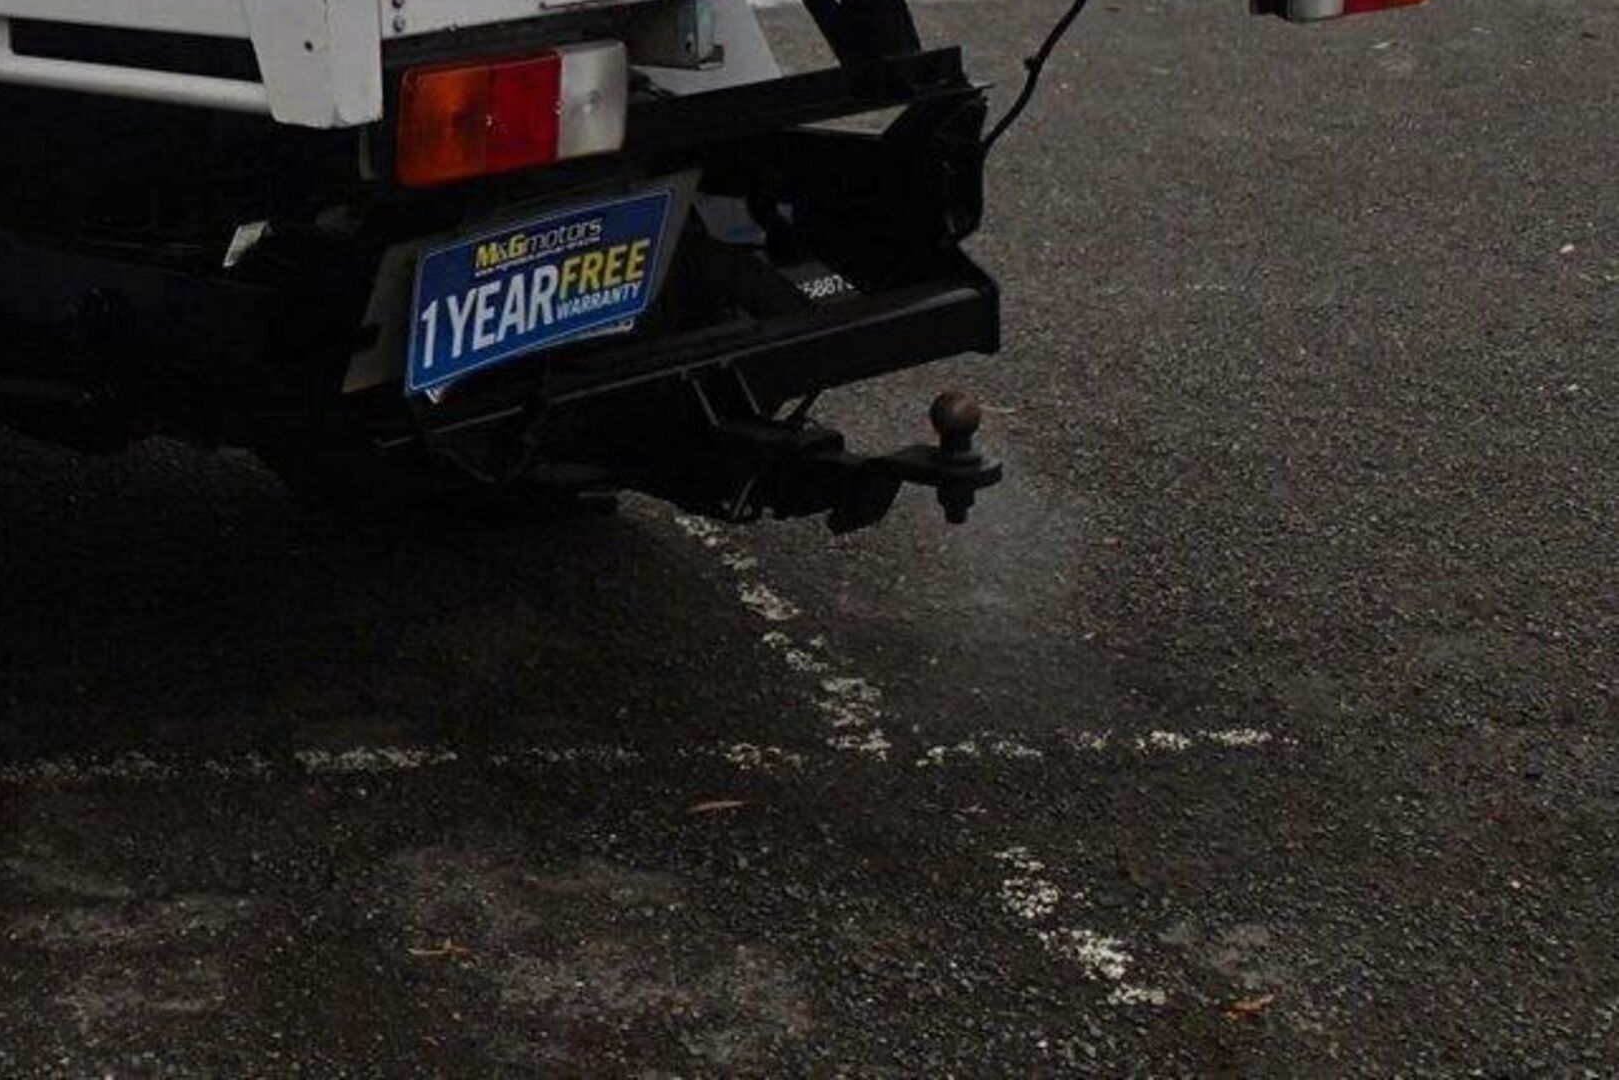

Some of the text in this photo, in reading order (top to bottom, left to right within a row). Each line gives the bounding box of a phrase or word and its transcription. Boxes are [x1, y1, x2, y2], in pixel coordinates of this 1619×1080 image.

[421, 238, 651, 368] 1 YEAR FREE
[556, 280, 644, 320] WARRANTY
